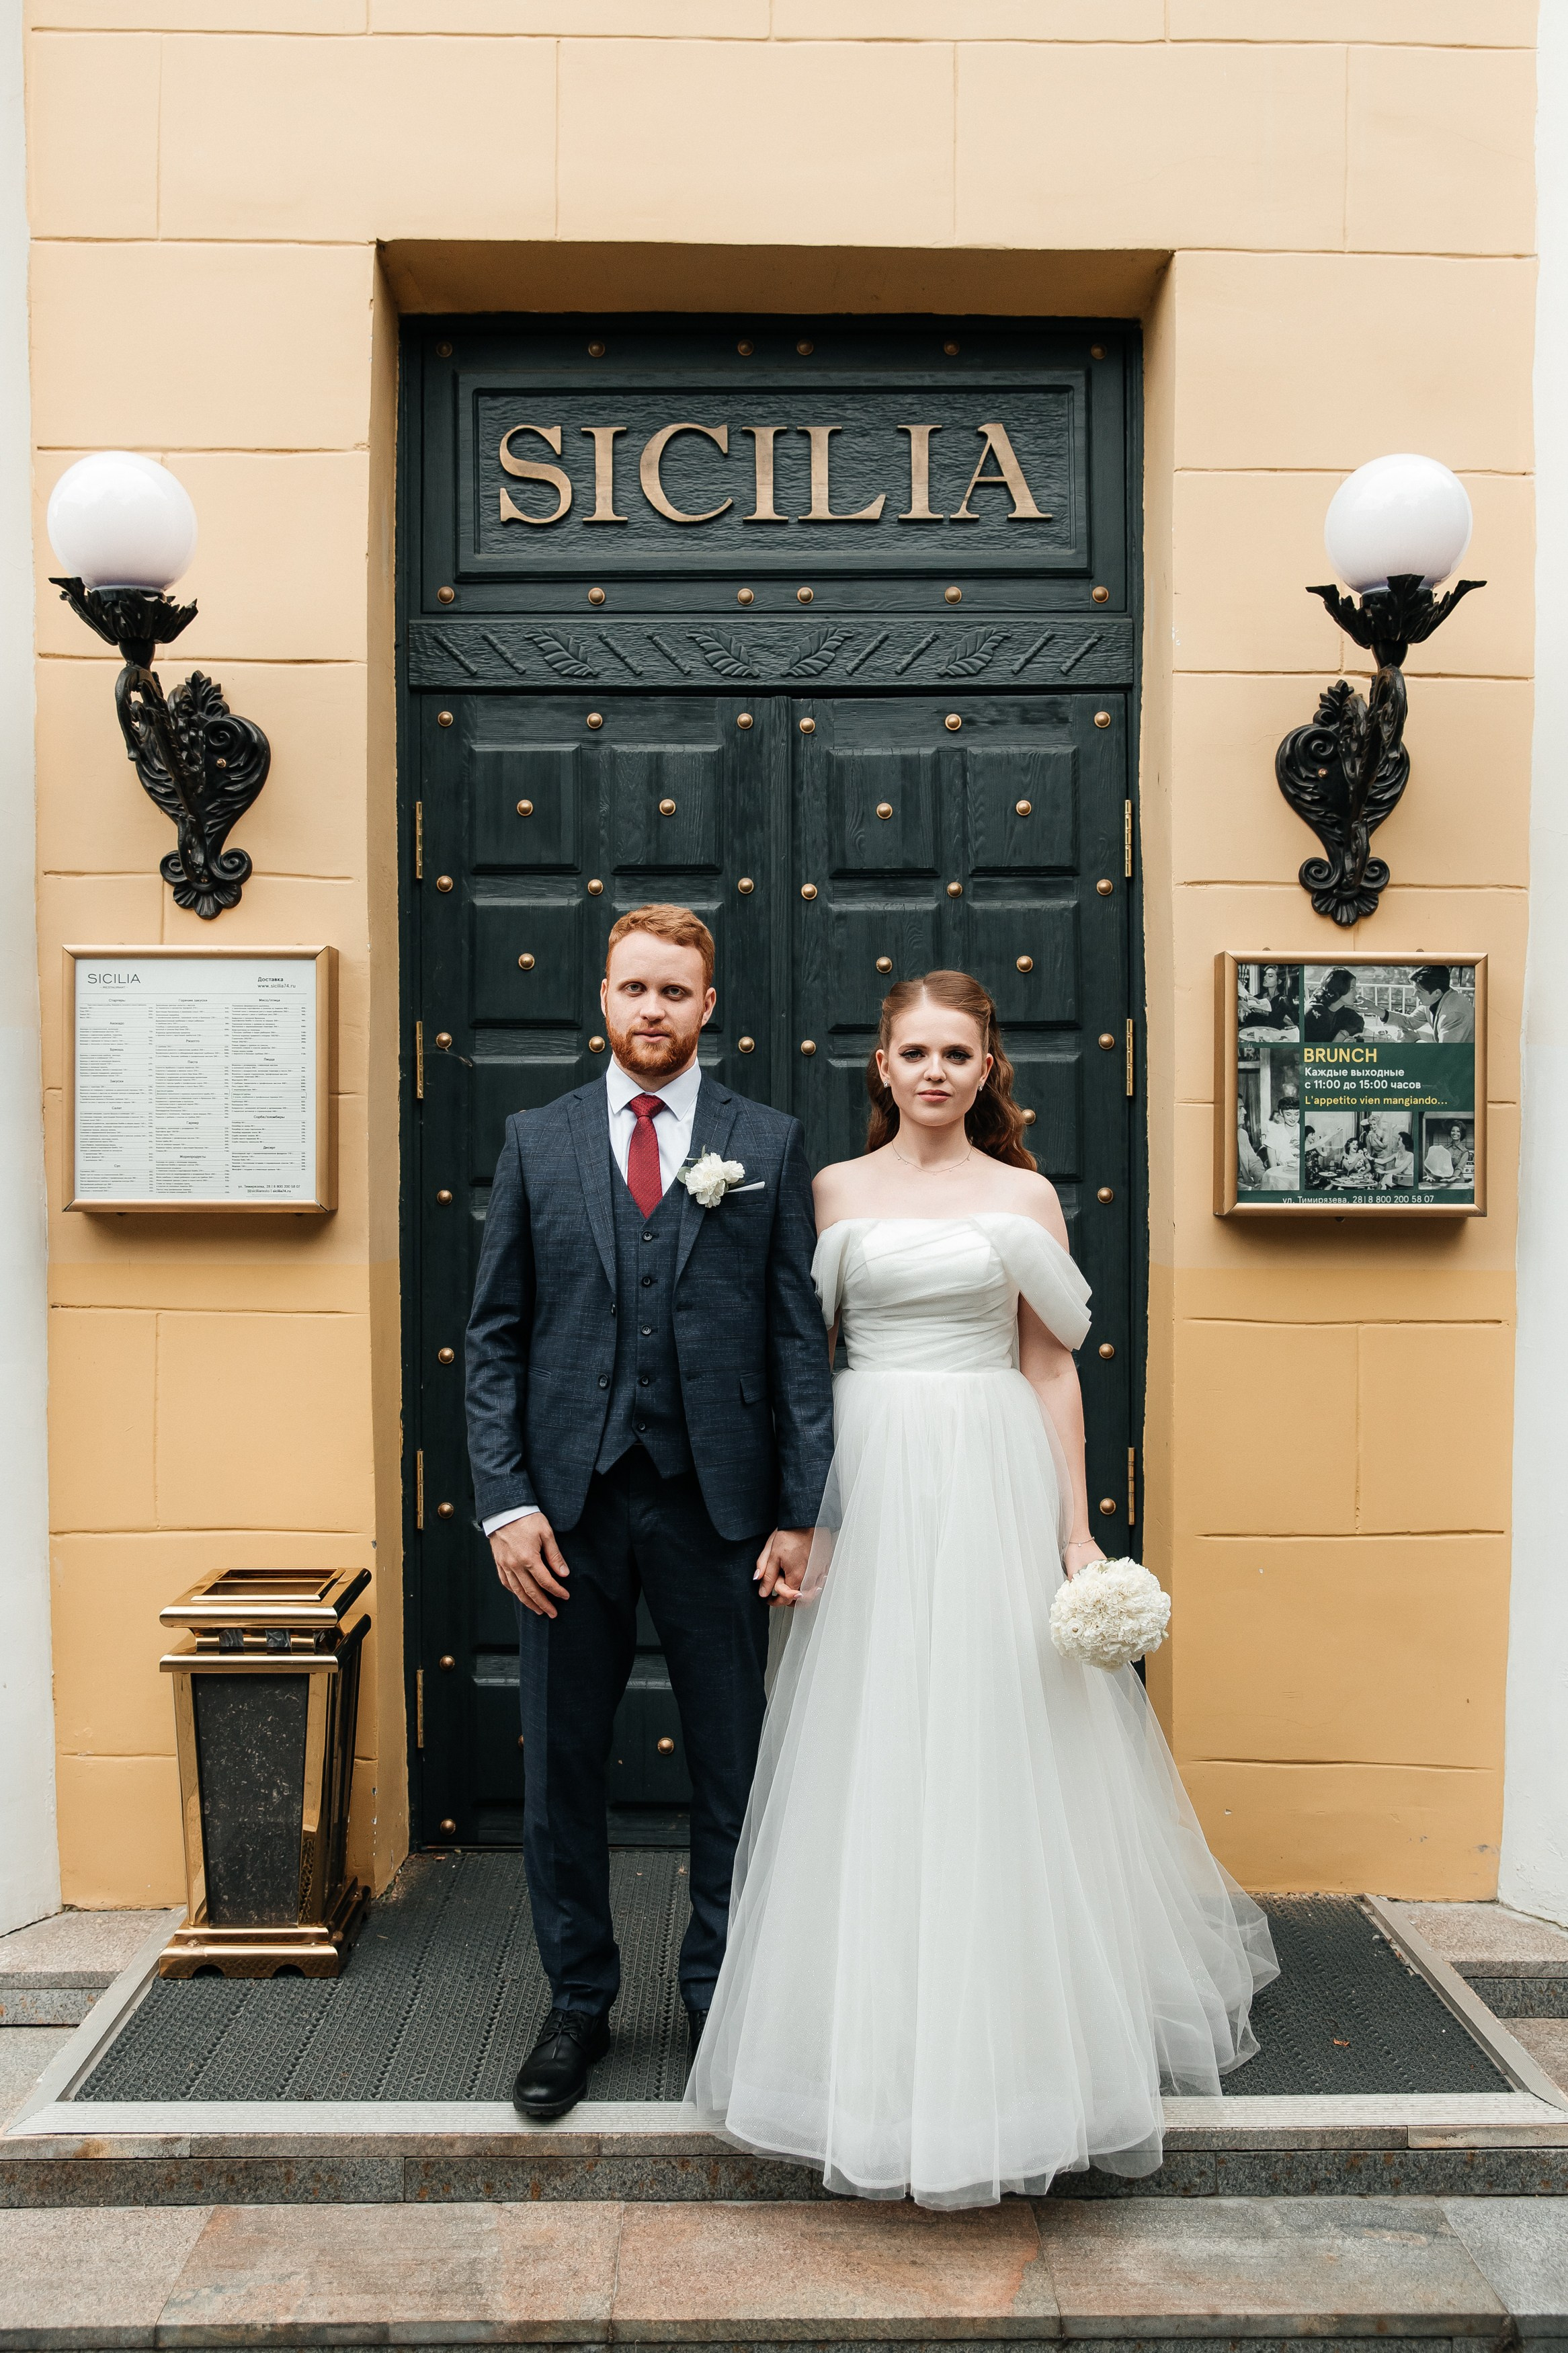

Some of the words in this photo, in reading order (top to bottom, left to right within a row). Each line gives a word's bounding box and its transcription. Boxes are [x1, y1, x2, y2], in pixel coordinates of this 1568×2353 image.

[499, 423, 1053, 524] SICILIA
[87, 973, 141, 984] SICILIA
[1304, 1048, 1376, 1062] BRUNCH
[1305, 1068, 1348, 1078] Каждые
[1351, 1068, 1404, 1077] выходные
[1315, 1080, 1340, 1089] 11:00
[1344, 1082, 1356, 1090] до
[1360, 1080, 1387, 1089] 15:00
[1305, 1096, 1356, 1106] L'appetito
[1360, 1096, 1380, 1105] vien
[1384, 1096, 1448, 1106] mangiando...
